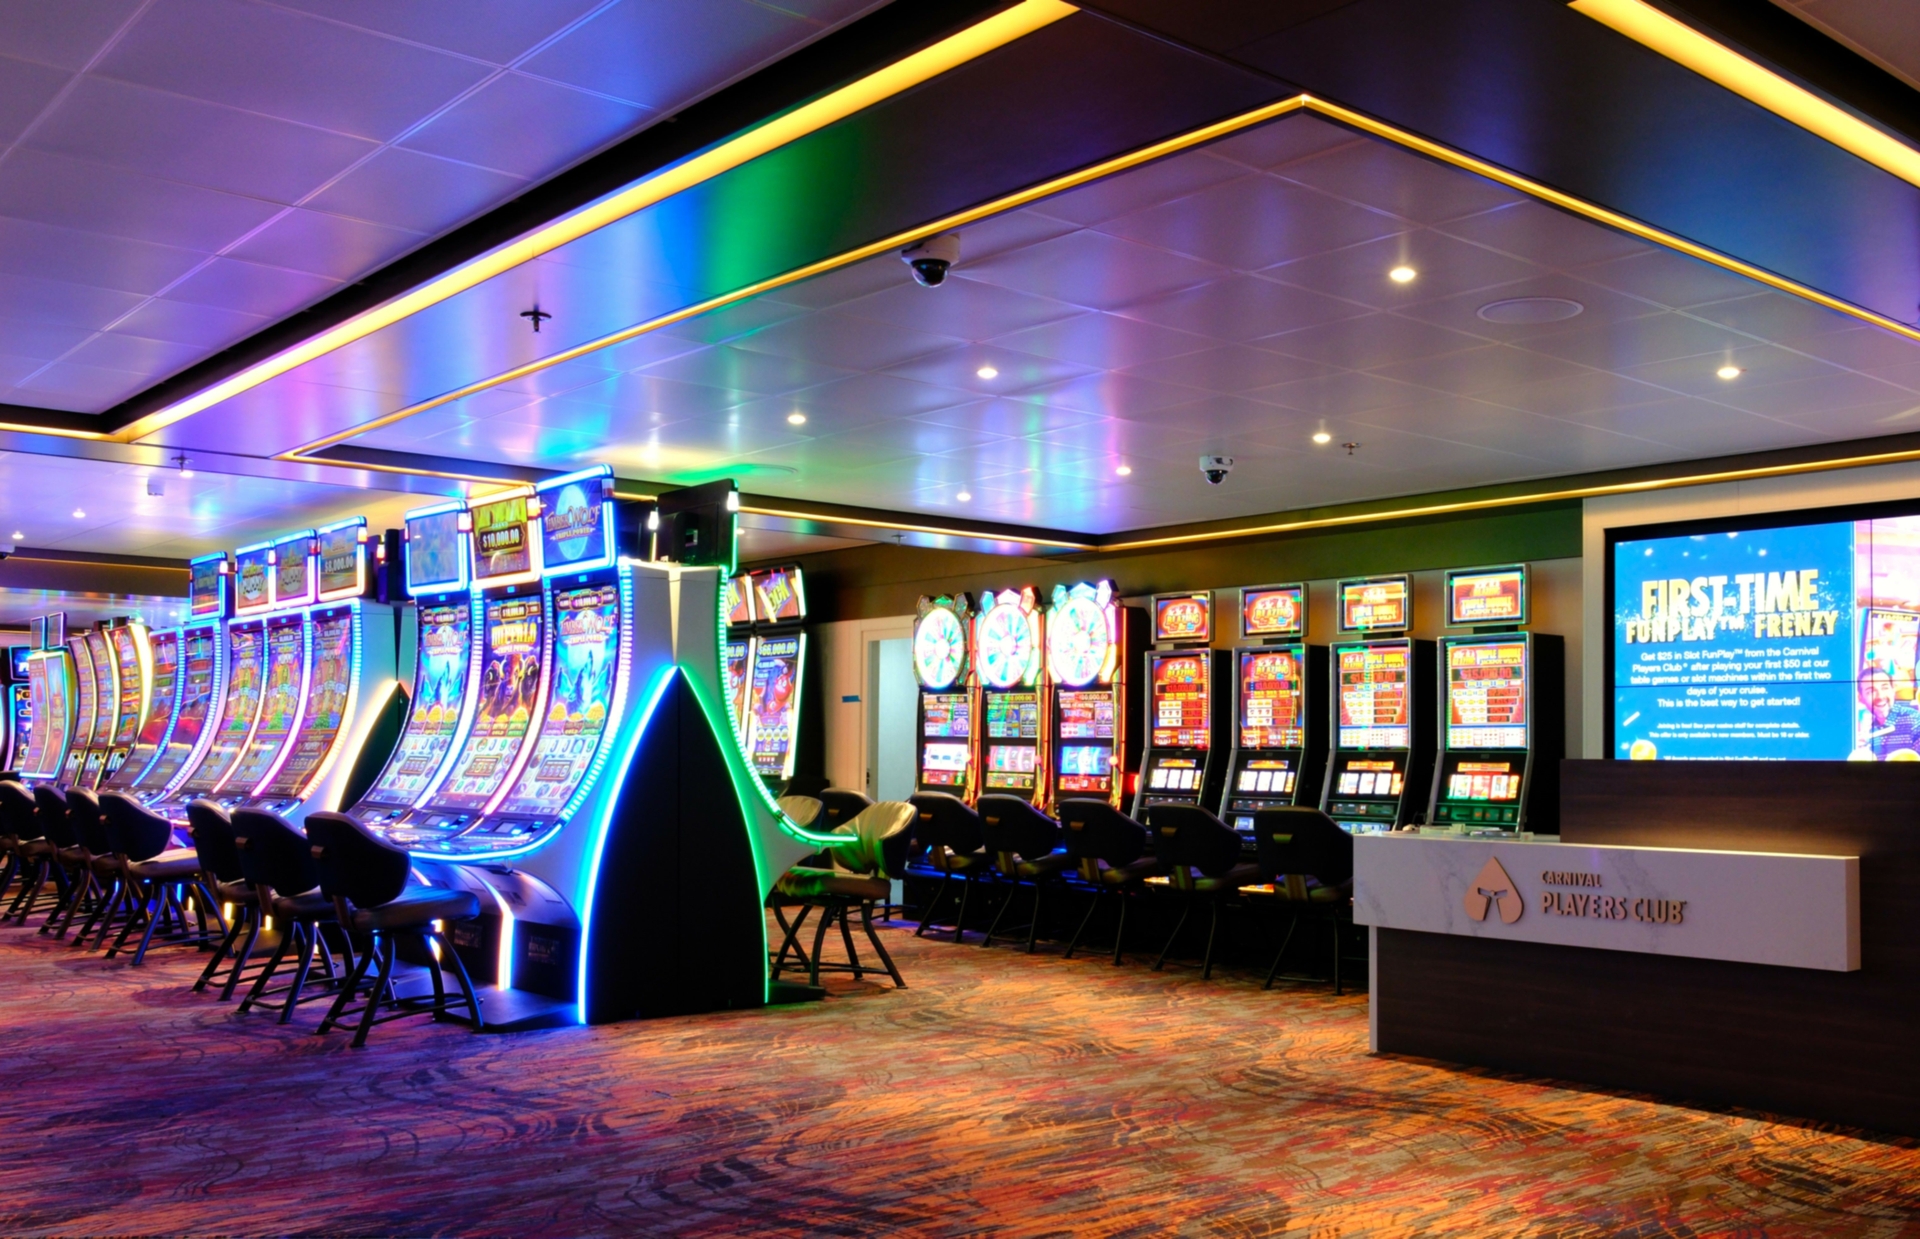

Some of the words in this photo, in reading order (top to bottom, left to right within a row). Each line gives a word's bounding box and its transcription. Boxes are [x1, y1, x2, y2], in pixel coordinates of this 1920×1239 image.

[568, 505, 601, 528] WOLF
[482, 528, 520, 548] $10,000.00
[1642, 569, 1819, 620] FIRST-TIME
[1754, 610, 1839, 638] FRENZY
[1641, 652, 1656, 661] Get
[1657, 651, 1673, 661] $25
[1674, 650, 1682, 660] in
[1683, 650, 1700, 660] Slot
[1744, 648, 1765, 658] from
[1766, 647, 1781, 657] the
[1782, 646, 1819, 656] Carnival
[1632, 664, 1661, 675] Players
[1690, 661, 1710, 671] after
[1711, 661, 1742, 672] playing
[1743, 661, 1763, 671] your
[1764, 659, 1782, 669] first
[1783, 659, 1801, 669] $50
[1802, 659, 1812, 668] at
[1813, 659, 1830, 668] our
[1350, 671, 1397, 684] $1500.00
[1691, 674, 1707, 683] slot
[1708, 673, 1749, 682] machines
[1750, 671, 1777, 681] within
[1778, 671, 1793, 681] the
[1794, 671, 1812, 680] first
[1813, 671, 1832, 680] two
[1686, 687, 1707, 697] days
[1708, 686, 1718, 695] of
[1719, 687, 1738, 697] your
[1739, 685, 1768, 695] cruise.
[1657, 698, 1675, 708] This
[1676, 698, 1684, 707] is
[1684, 698, 1699, 708] the
[1700, 698, 1719, 707] best
[1720, 699, 1738, 709] way
[1739, 697, 1749, 707] to
[1750, 697, 1765, 709] get
[1541, 870, 1602, 888] CARNIVAL
[1541, 892, 1627, 920] PLAYERS
